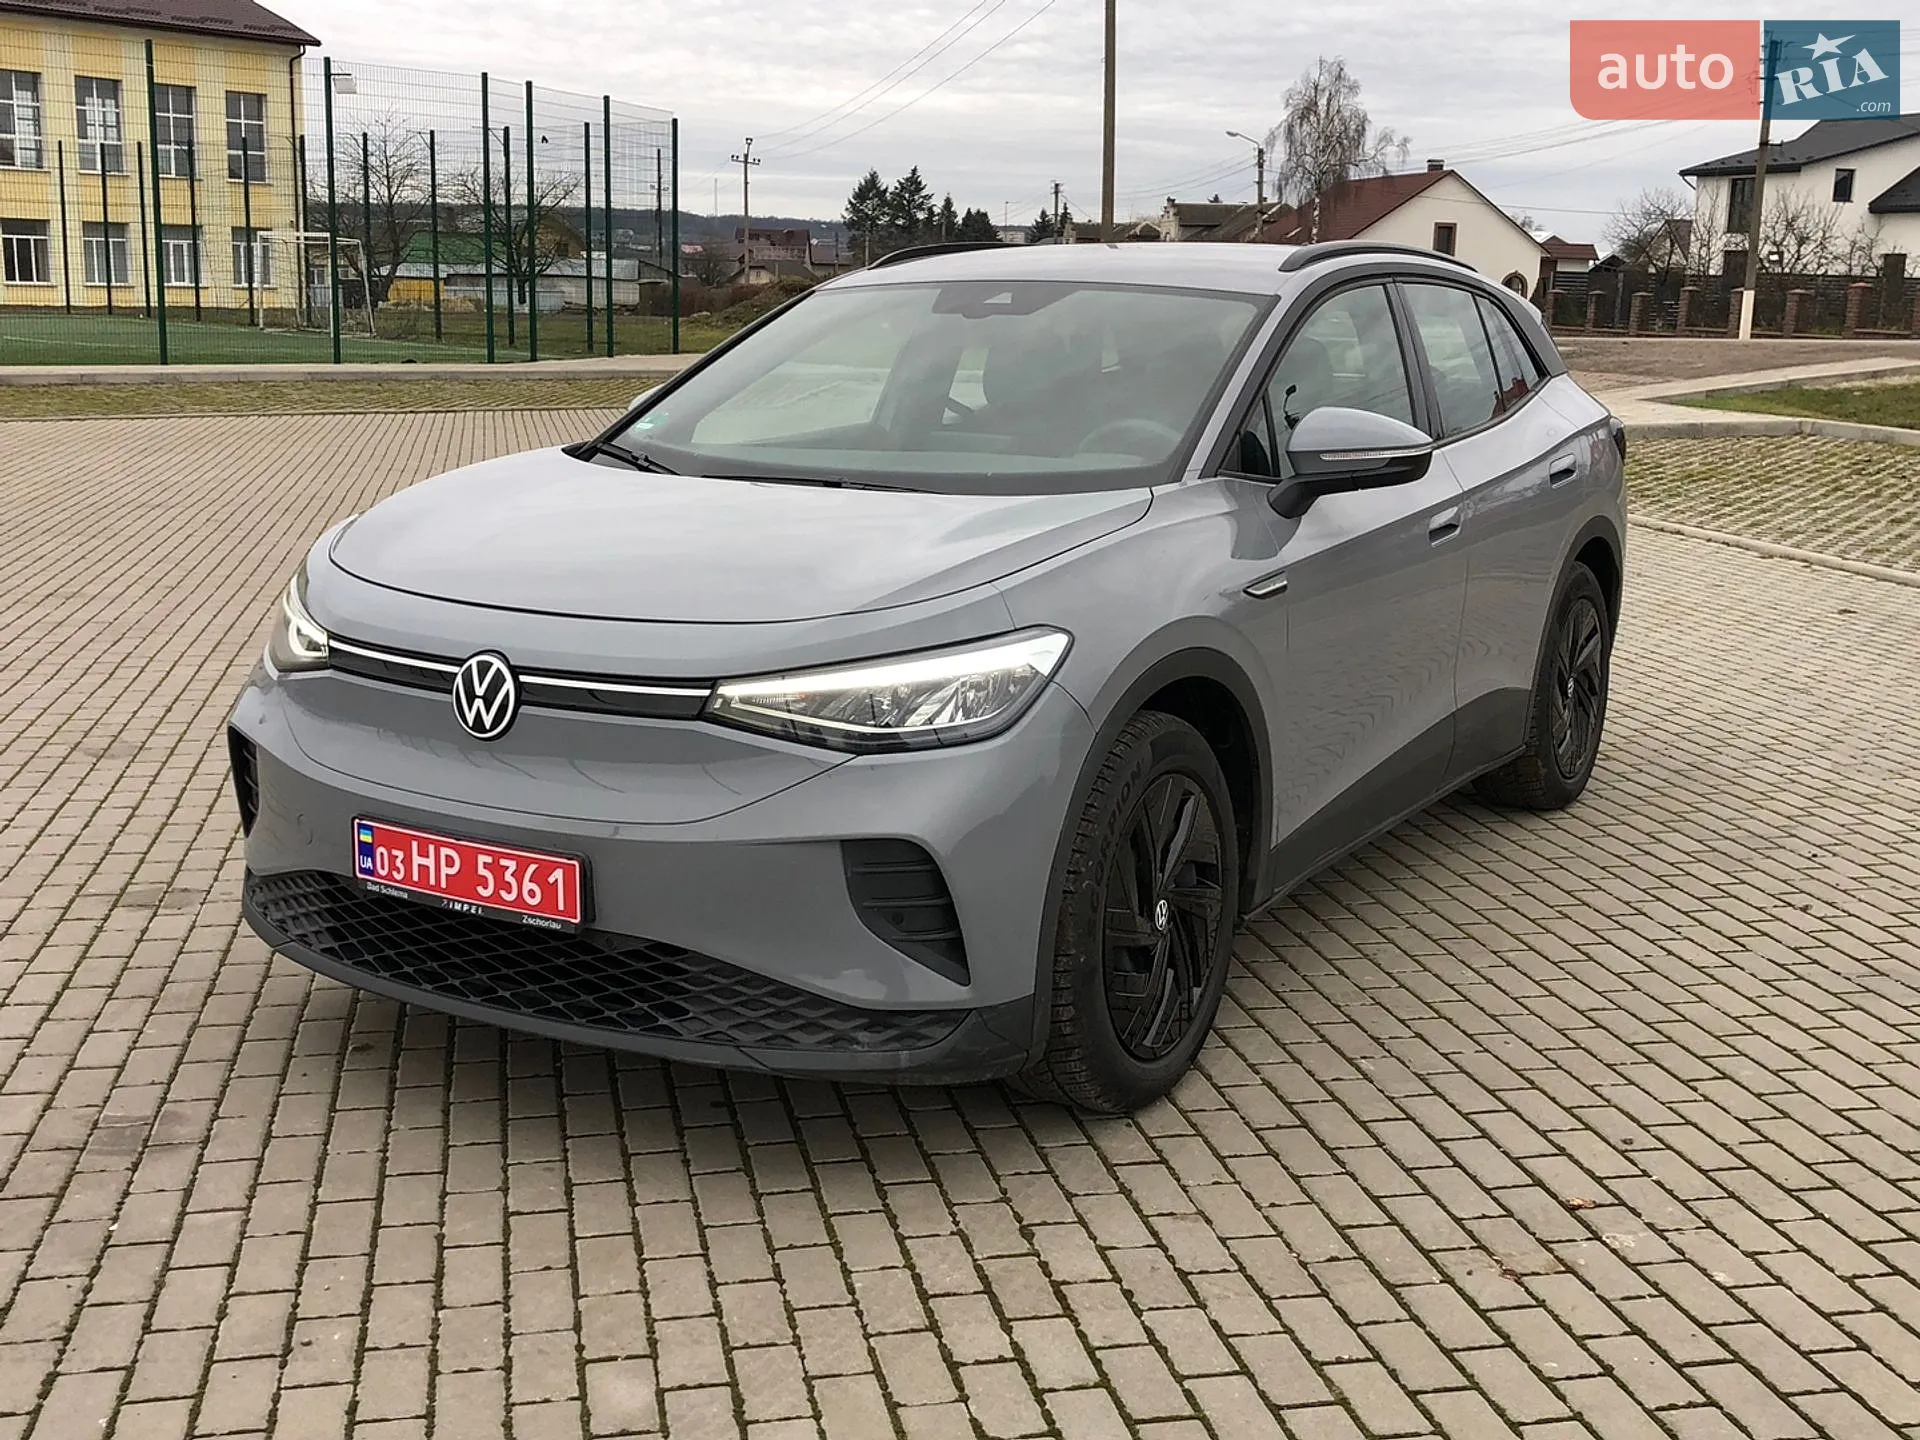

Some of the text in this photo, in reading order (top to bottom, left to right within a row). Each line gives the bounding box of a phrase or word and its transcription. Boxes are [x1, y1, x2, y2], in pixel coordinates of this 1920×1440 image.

[360, 855, 373, 870] UA
[376, 840, 566, 911] 03 HP 5361
